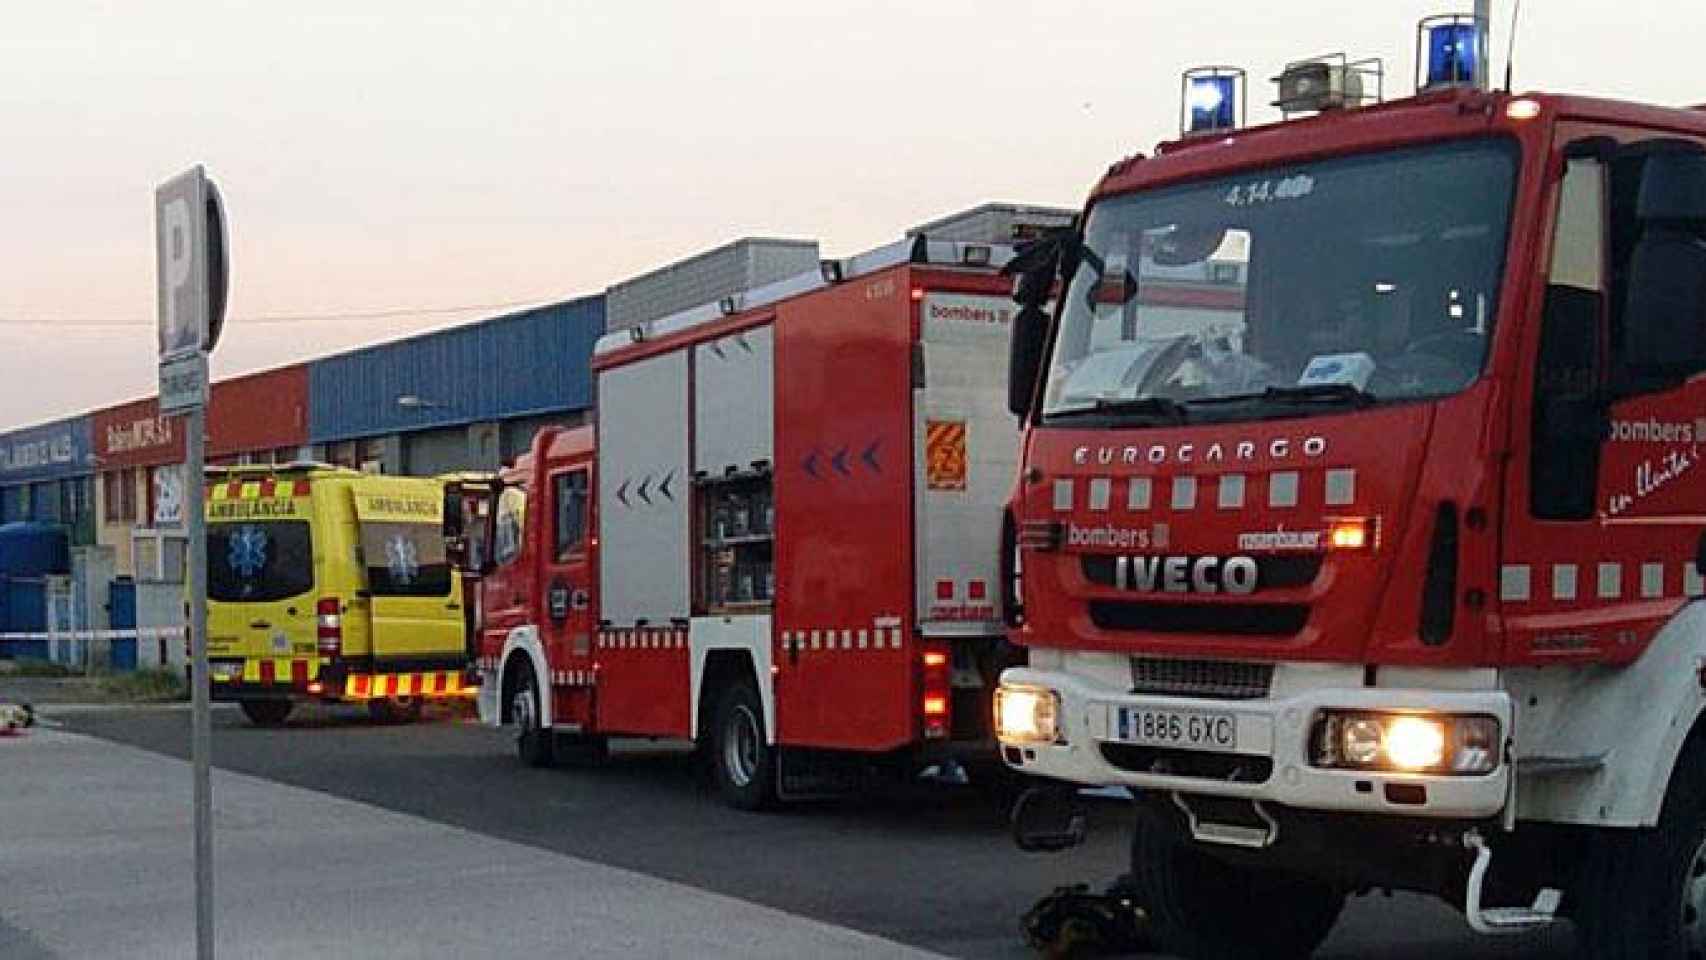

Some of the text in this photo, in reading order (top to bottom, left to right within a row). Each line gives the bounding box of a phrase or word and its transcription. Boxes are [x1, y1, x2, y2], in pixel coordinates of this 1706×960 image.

[164, 199, 192, 330] P
[931, 304, 994, 323] bombers
[1073, 436, 1326, 465] EUROCARGO
[1069, 523, 1149, 548] bombers
[1115, 556, 1258, 593] IVECO
[1133, 711, 1231, 744] 1886 GXC
